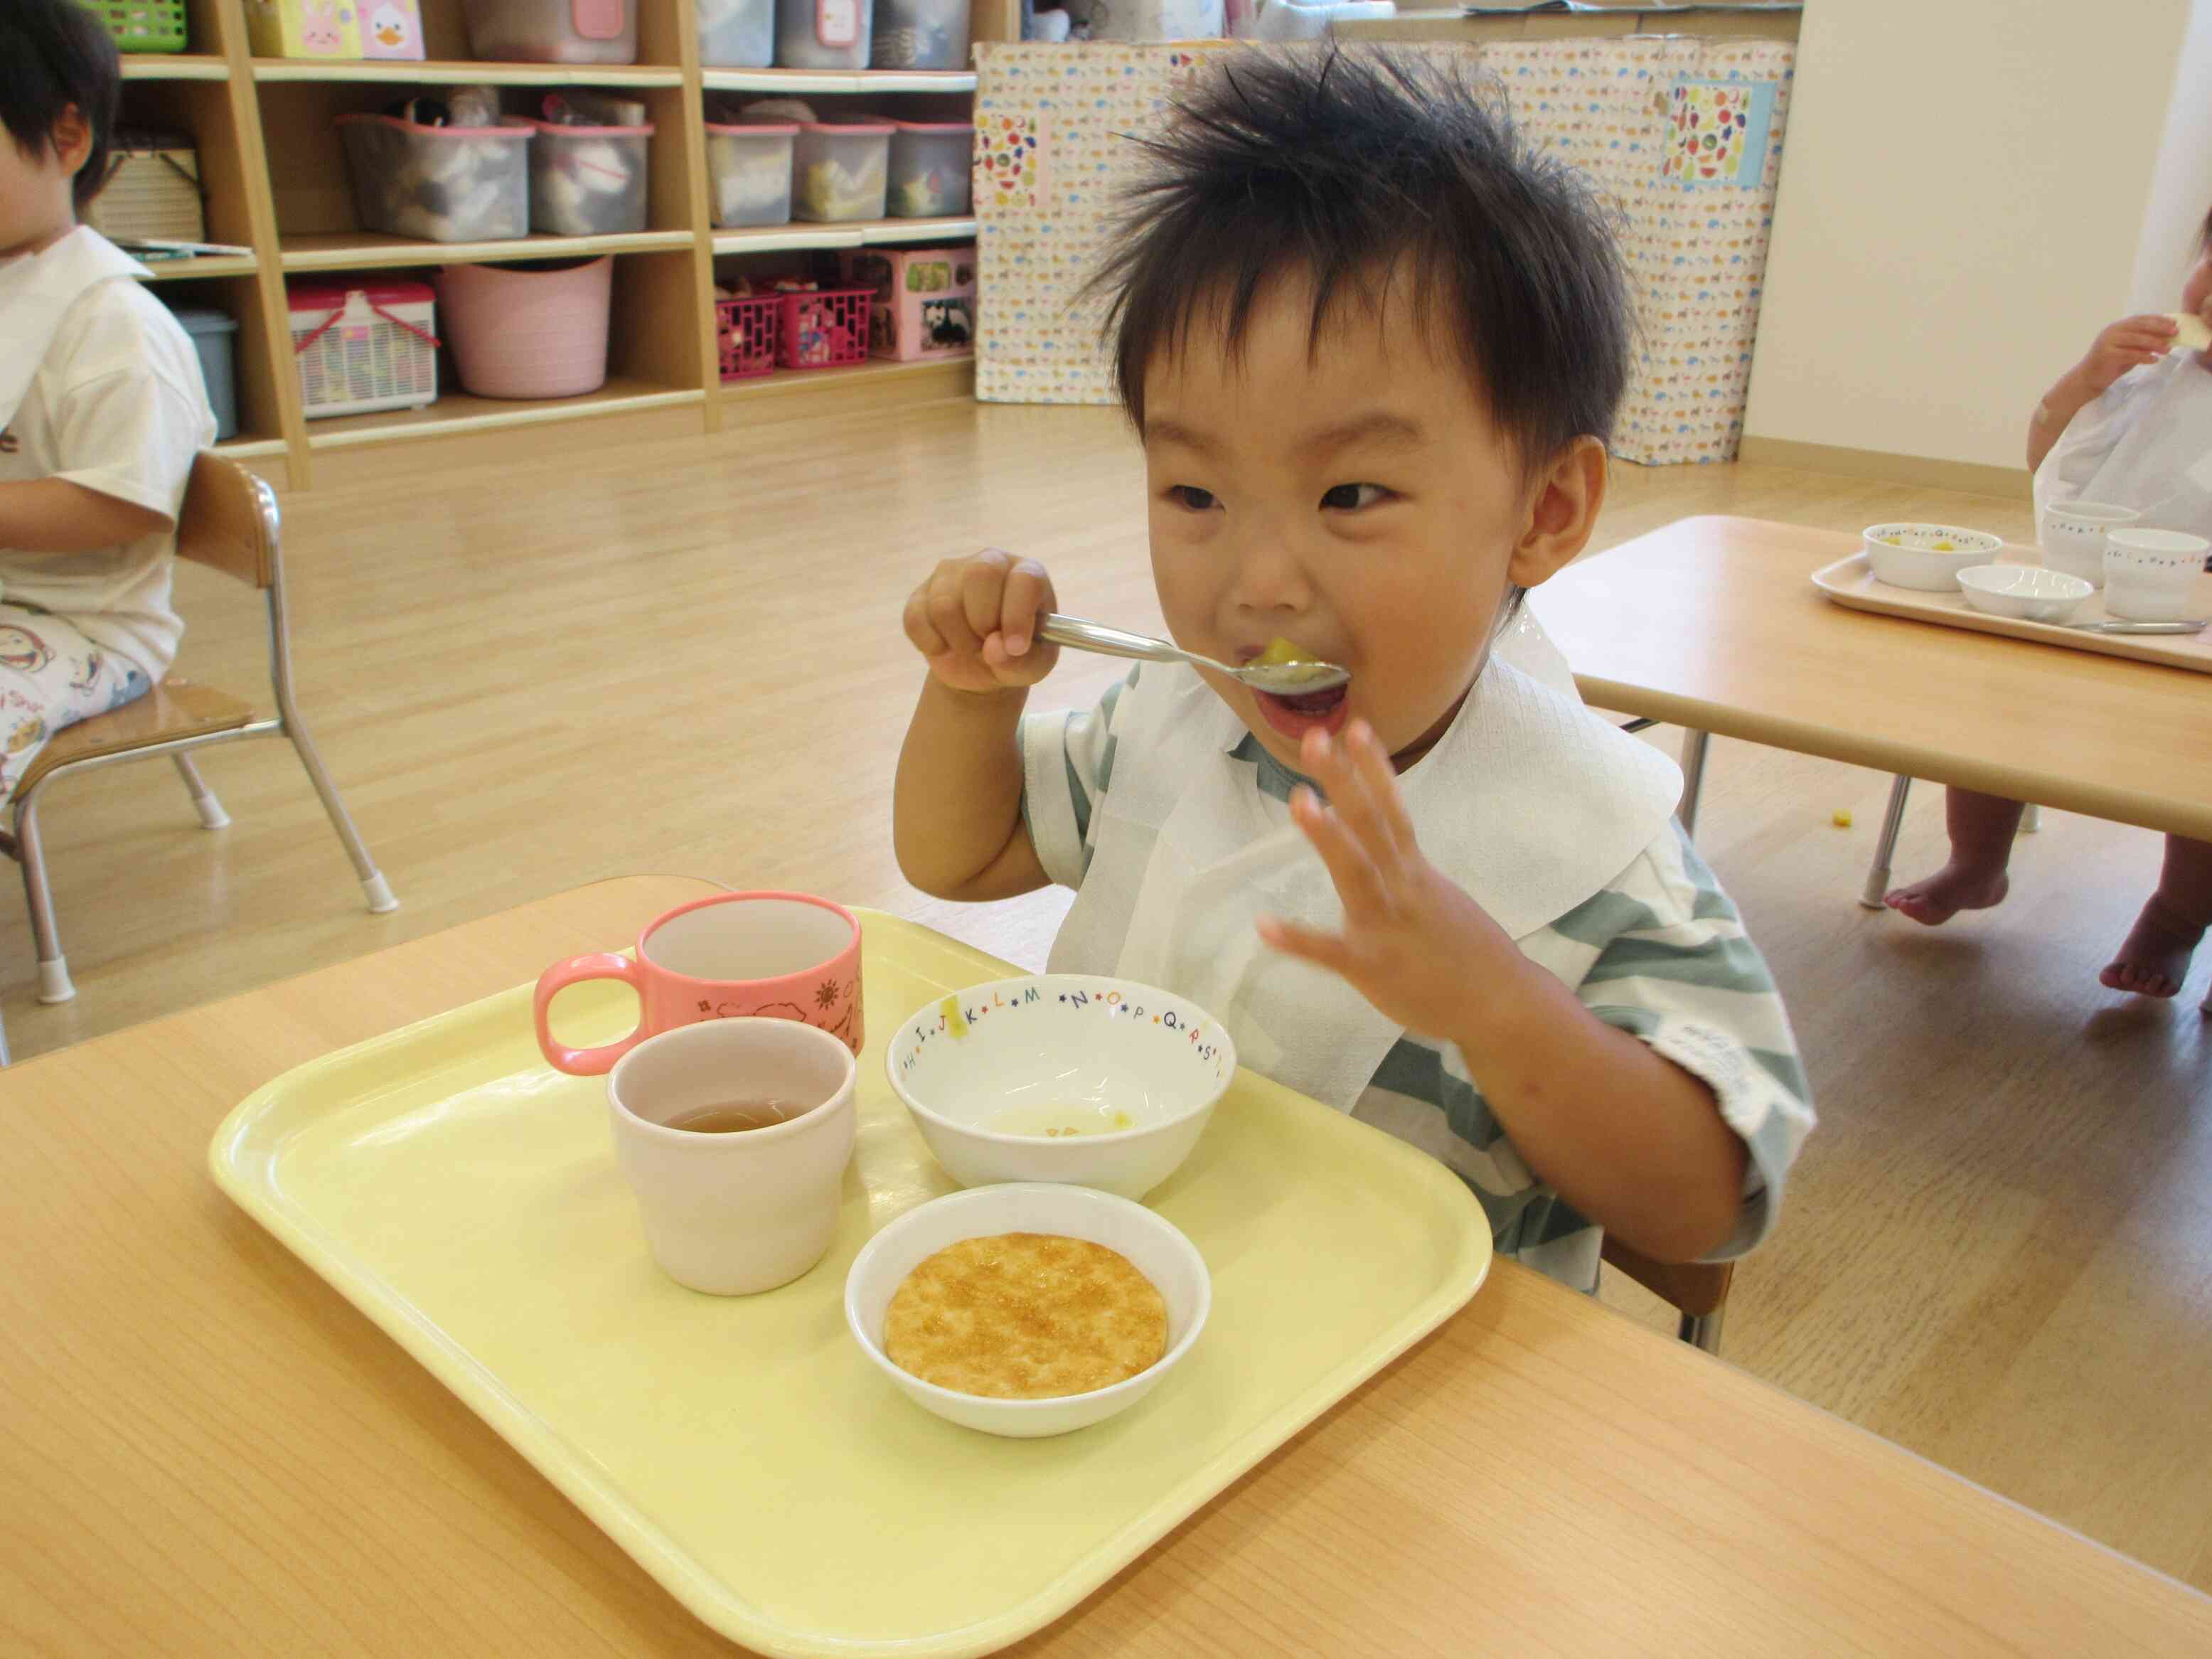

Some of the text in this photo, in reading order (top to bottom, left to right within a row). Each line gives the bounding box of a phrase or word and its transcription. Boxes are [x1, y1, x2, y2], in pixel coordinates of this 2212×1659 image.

[907, 987, 1211, 1069] H I J K L M N O P Q R S
